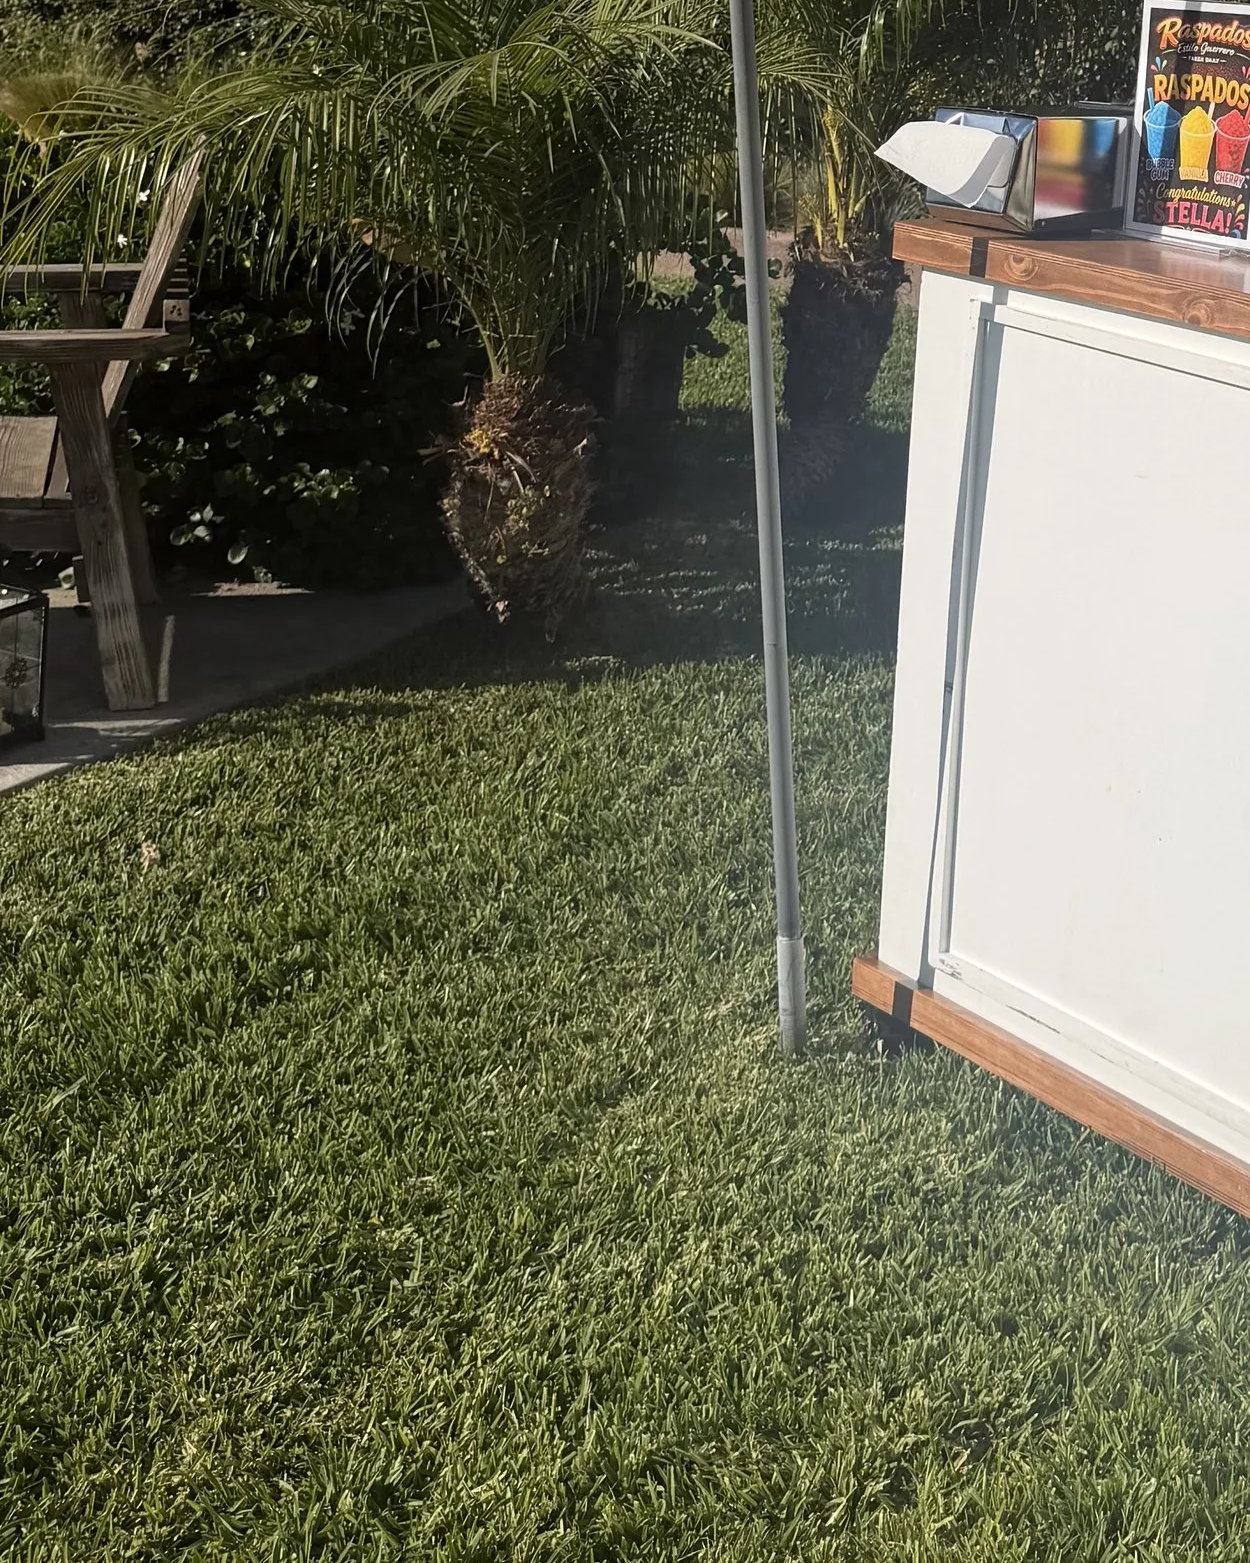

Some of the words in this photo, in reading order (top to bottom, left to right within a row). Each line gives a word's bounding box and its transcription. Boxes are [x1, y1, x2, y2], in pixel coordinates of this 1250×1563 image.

[1177, 42, 1198, 53] Estilo
[1200, 42, 1235, 55] Guerrero
[1154, 74, 1250, 110] RASPADOS
[1146, 158, 1174, 171] BUBBLE
[1150, 168, 1169, 180] GUM
[1214, 170, 1245, 188] CHERRY
[1156, 182, 1232, 207] Congratulations
[1153, 200, 1232, 234] STELLA!
